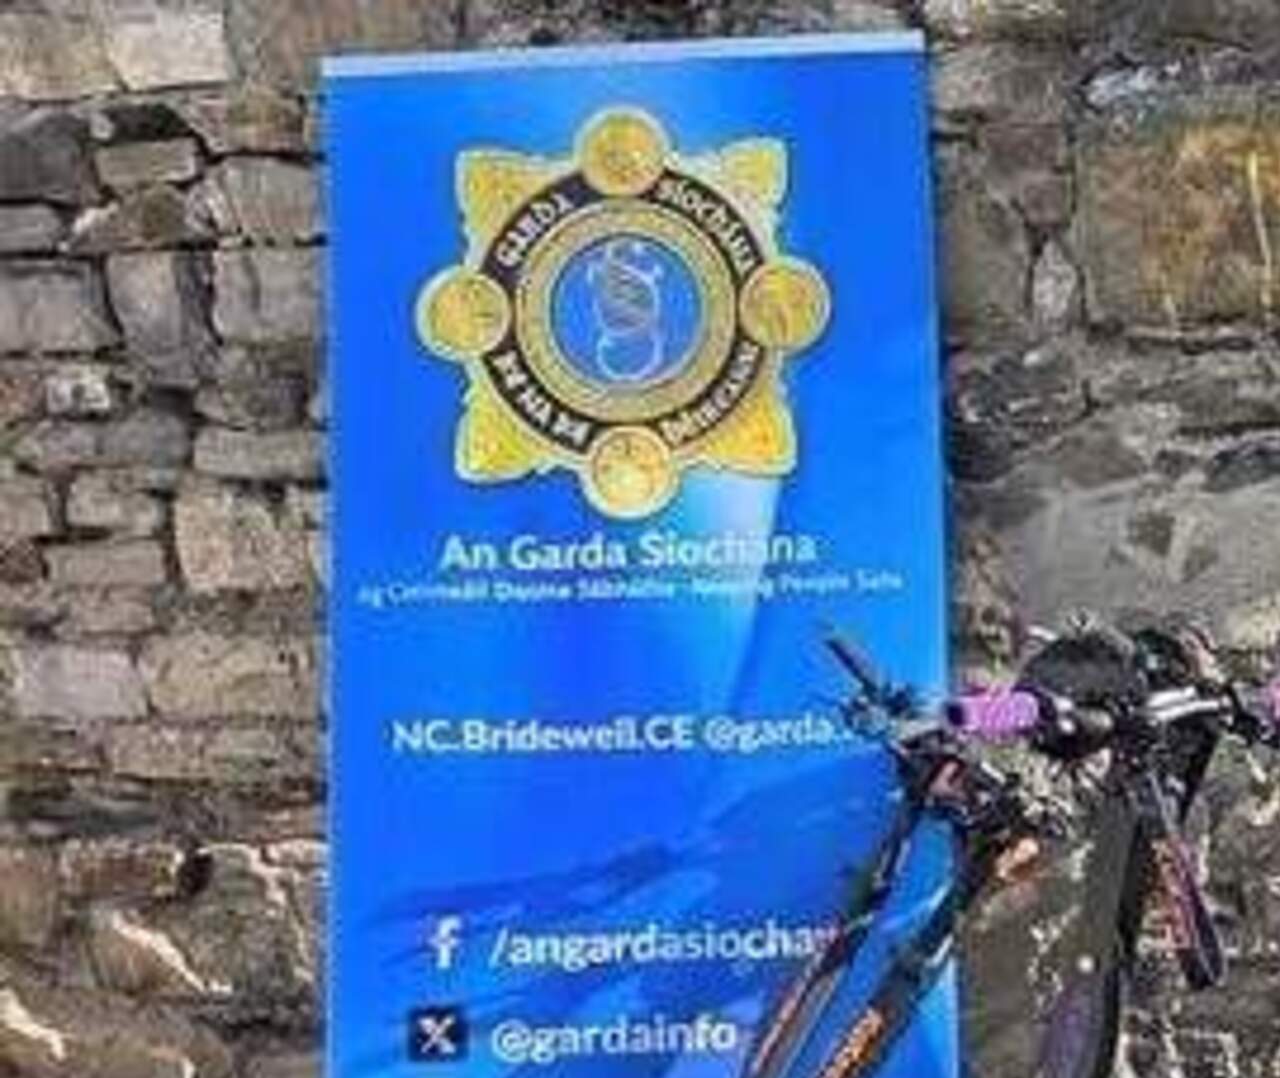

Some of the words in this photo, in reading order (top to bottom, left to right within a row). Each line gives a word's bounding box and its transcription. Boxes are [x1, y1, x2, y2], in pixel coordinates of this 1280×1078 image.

[439, 534, 499, 570] An
[509, 530, 628, 571] Garda
[491, 1014, 738, 1062] @gardainfo
